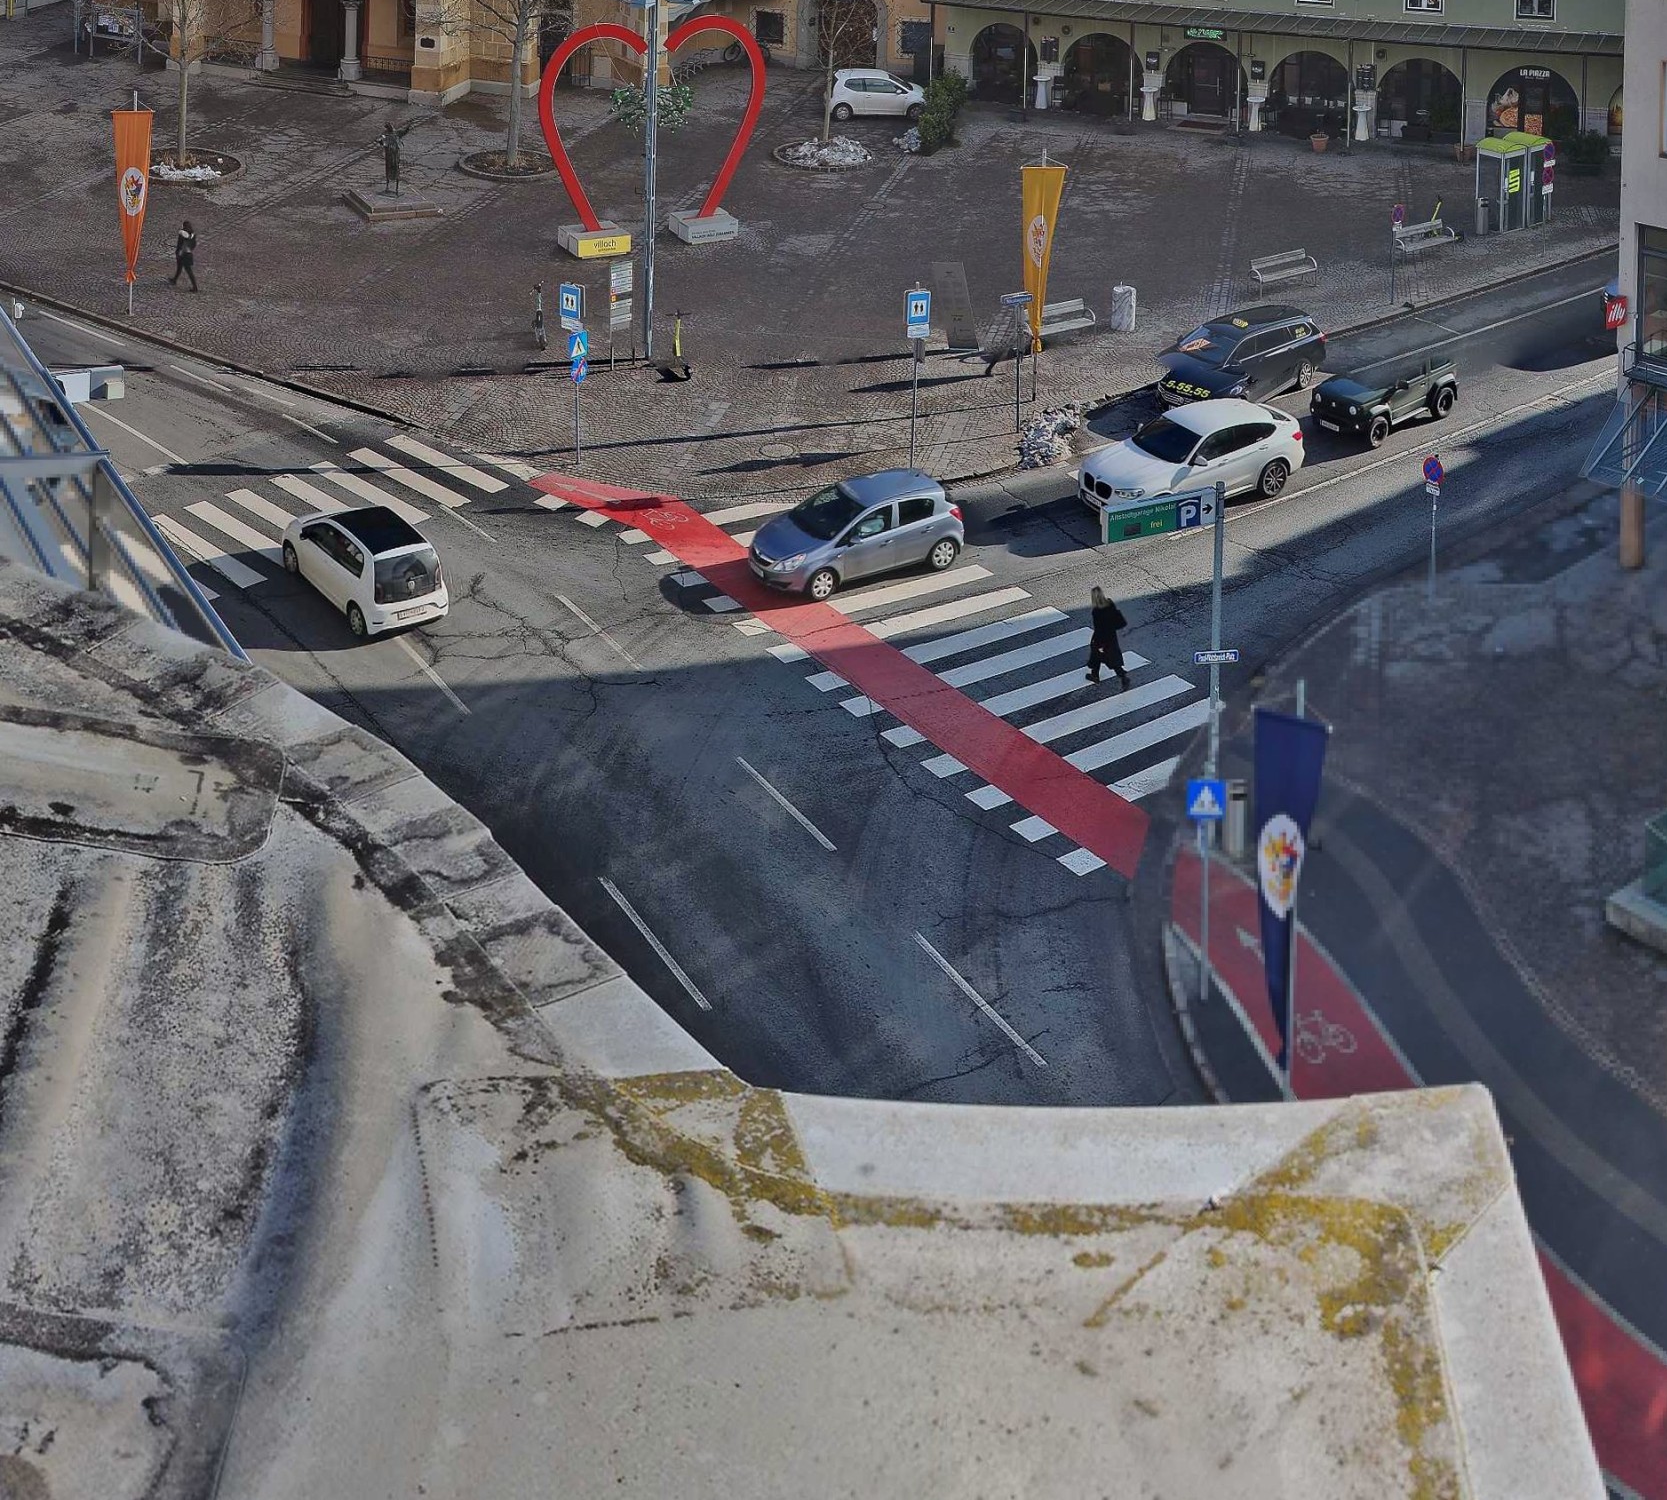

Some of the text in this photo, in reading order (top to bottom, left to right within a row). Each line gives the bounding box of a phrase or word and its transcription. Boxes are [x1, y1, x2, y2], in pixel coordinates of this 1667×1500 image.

[1528, 69, 1550, 78] PIAZZA
[593, 239, 617, 250] villach
[1607, 303, 1627, 325] illy
[1165, 379, 1212, 399] 5.55.55
[1109, 502, 1177, 522] Altstadtgarage Nikolai
[1180, 504, 1197, 528] P
[1150, 520, 1163, 529] frei
